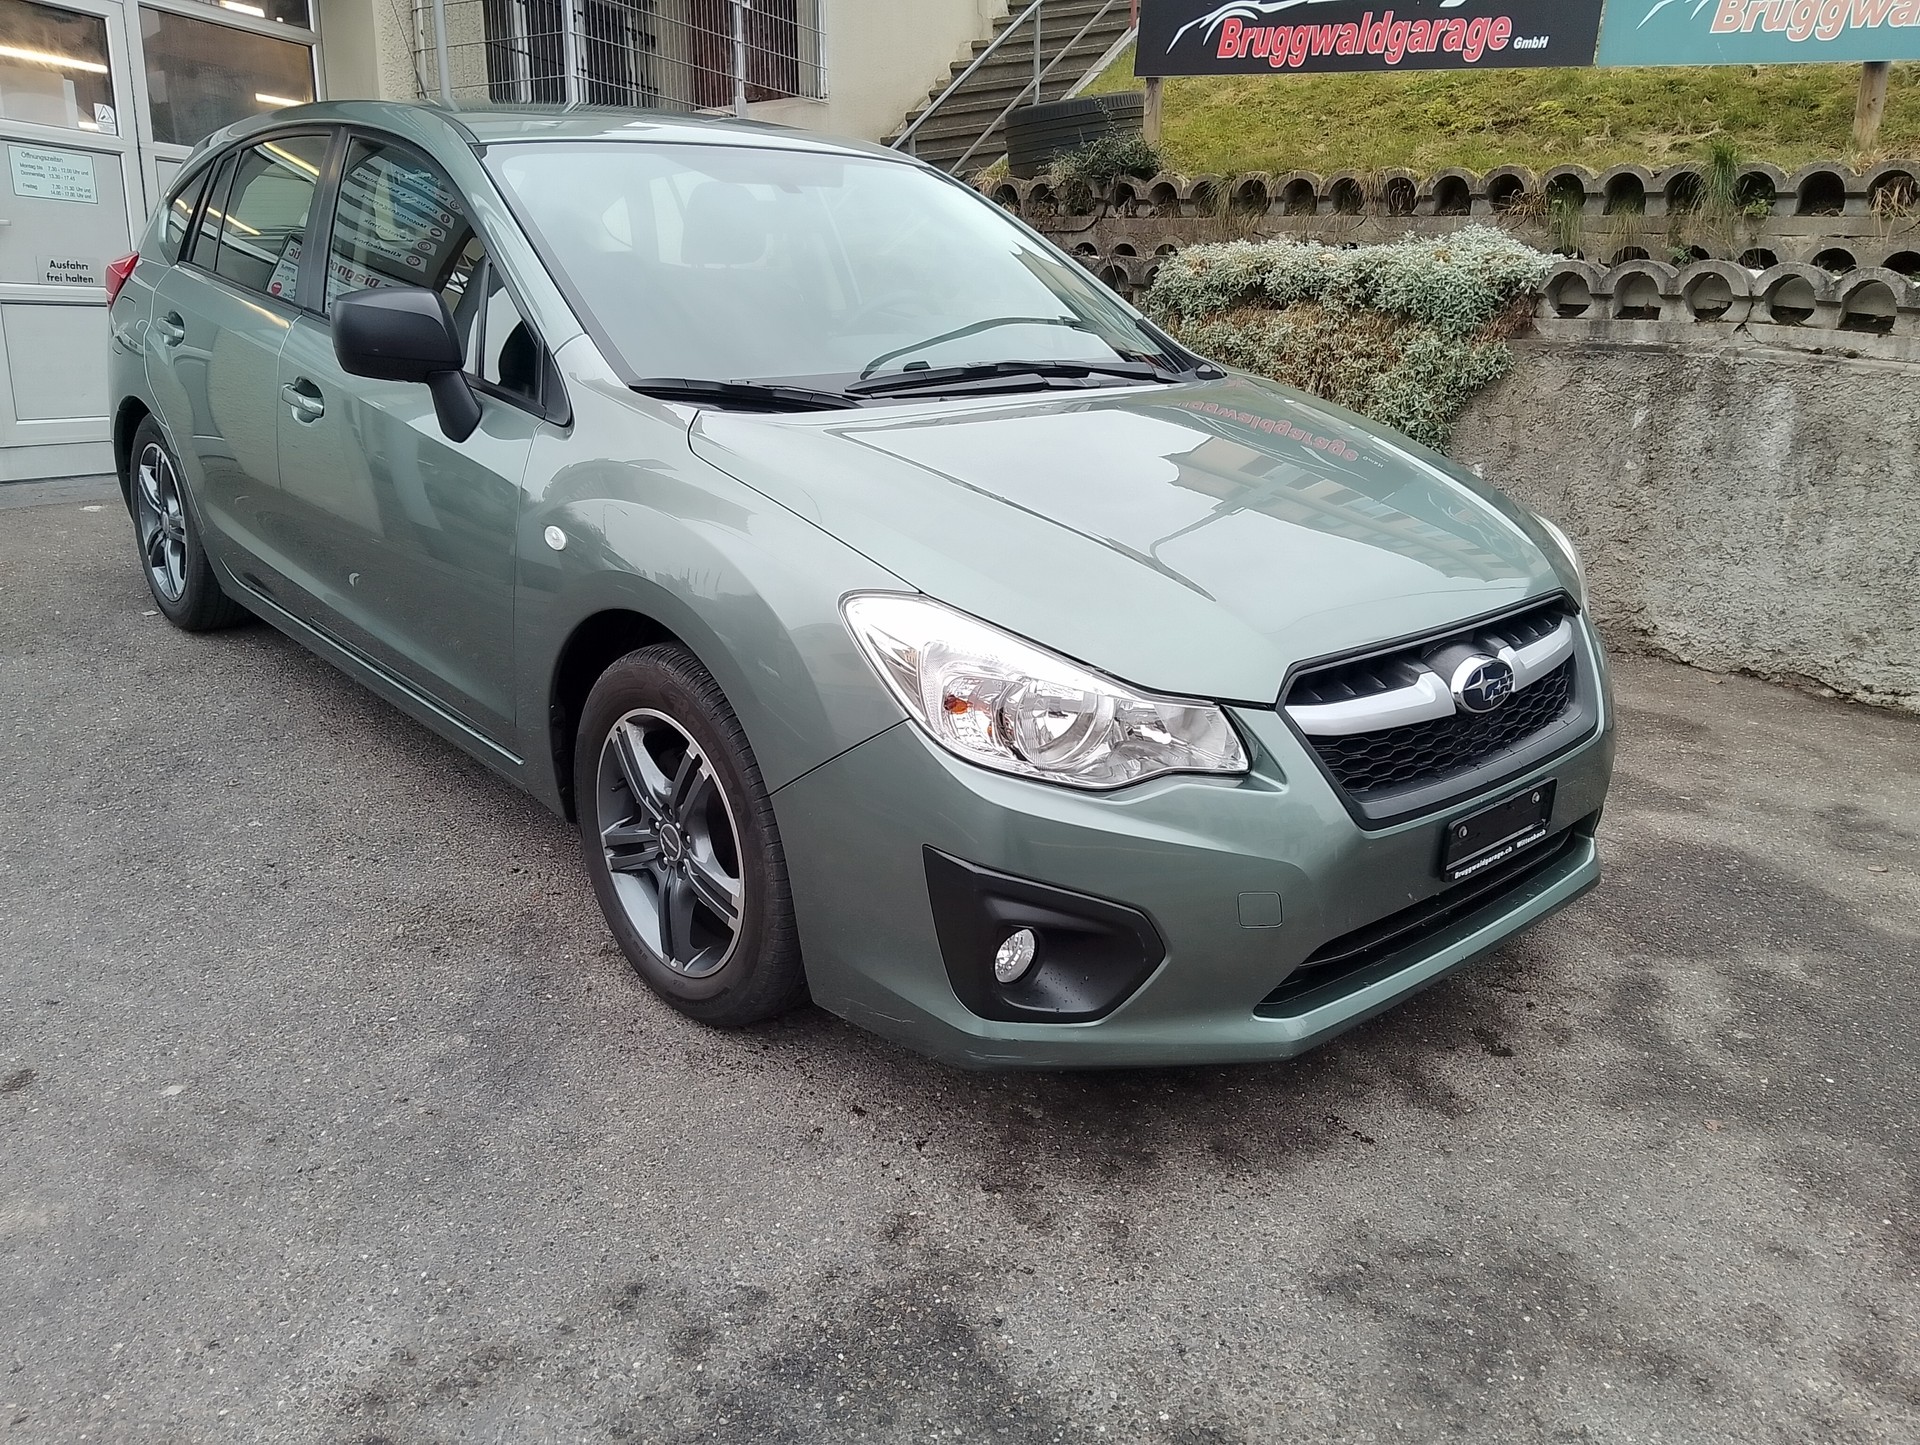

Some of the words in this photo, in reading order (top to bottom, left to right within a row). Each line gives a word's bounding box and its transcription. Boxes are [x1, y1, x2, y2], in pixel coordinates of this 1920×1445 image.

[1216, 11, 1512, 68] Bruggwaldgarage
[1513, 36, 1549, 49] GmbH
[1709, 0, 1920, 42] Bruggwa
[46, 272, 63, 282] frei
[65, 273, 94, 283] halten
[1455, 846, 1512, 879] Bruggwaldgarage.ch
